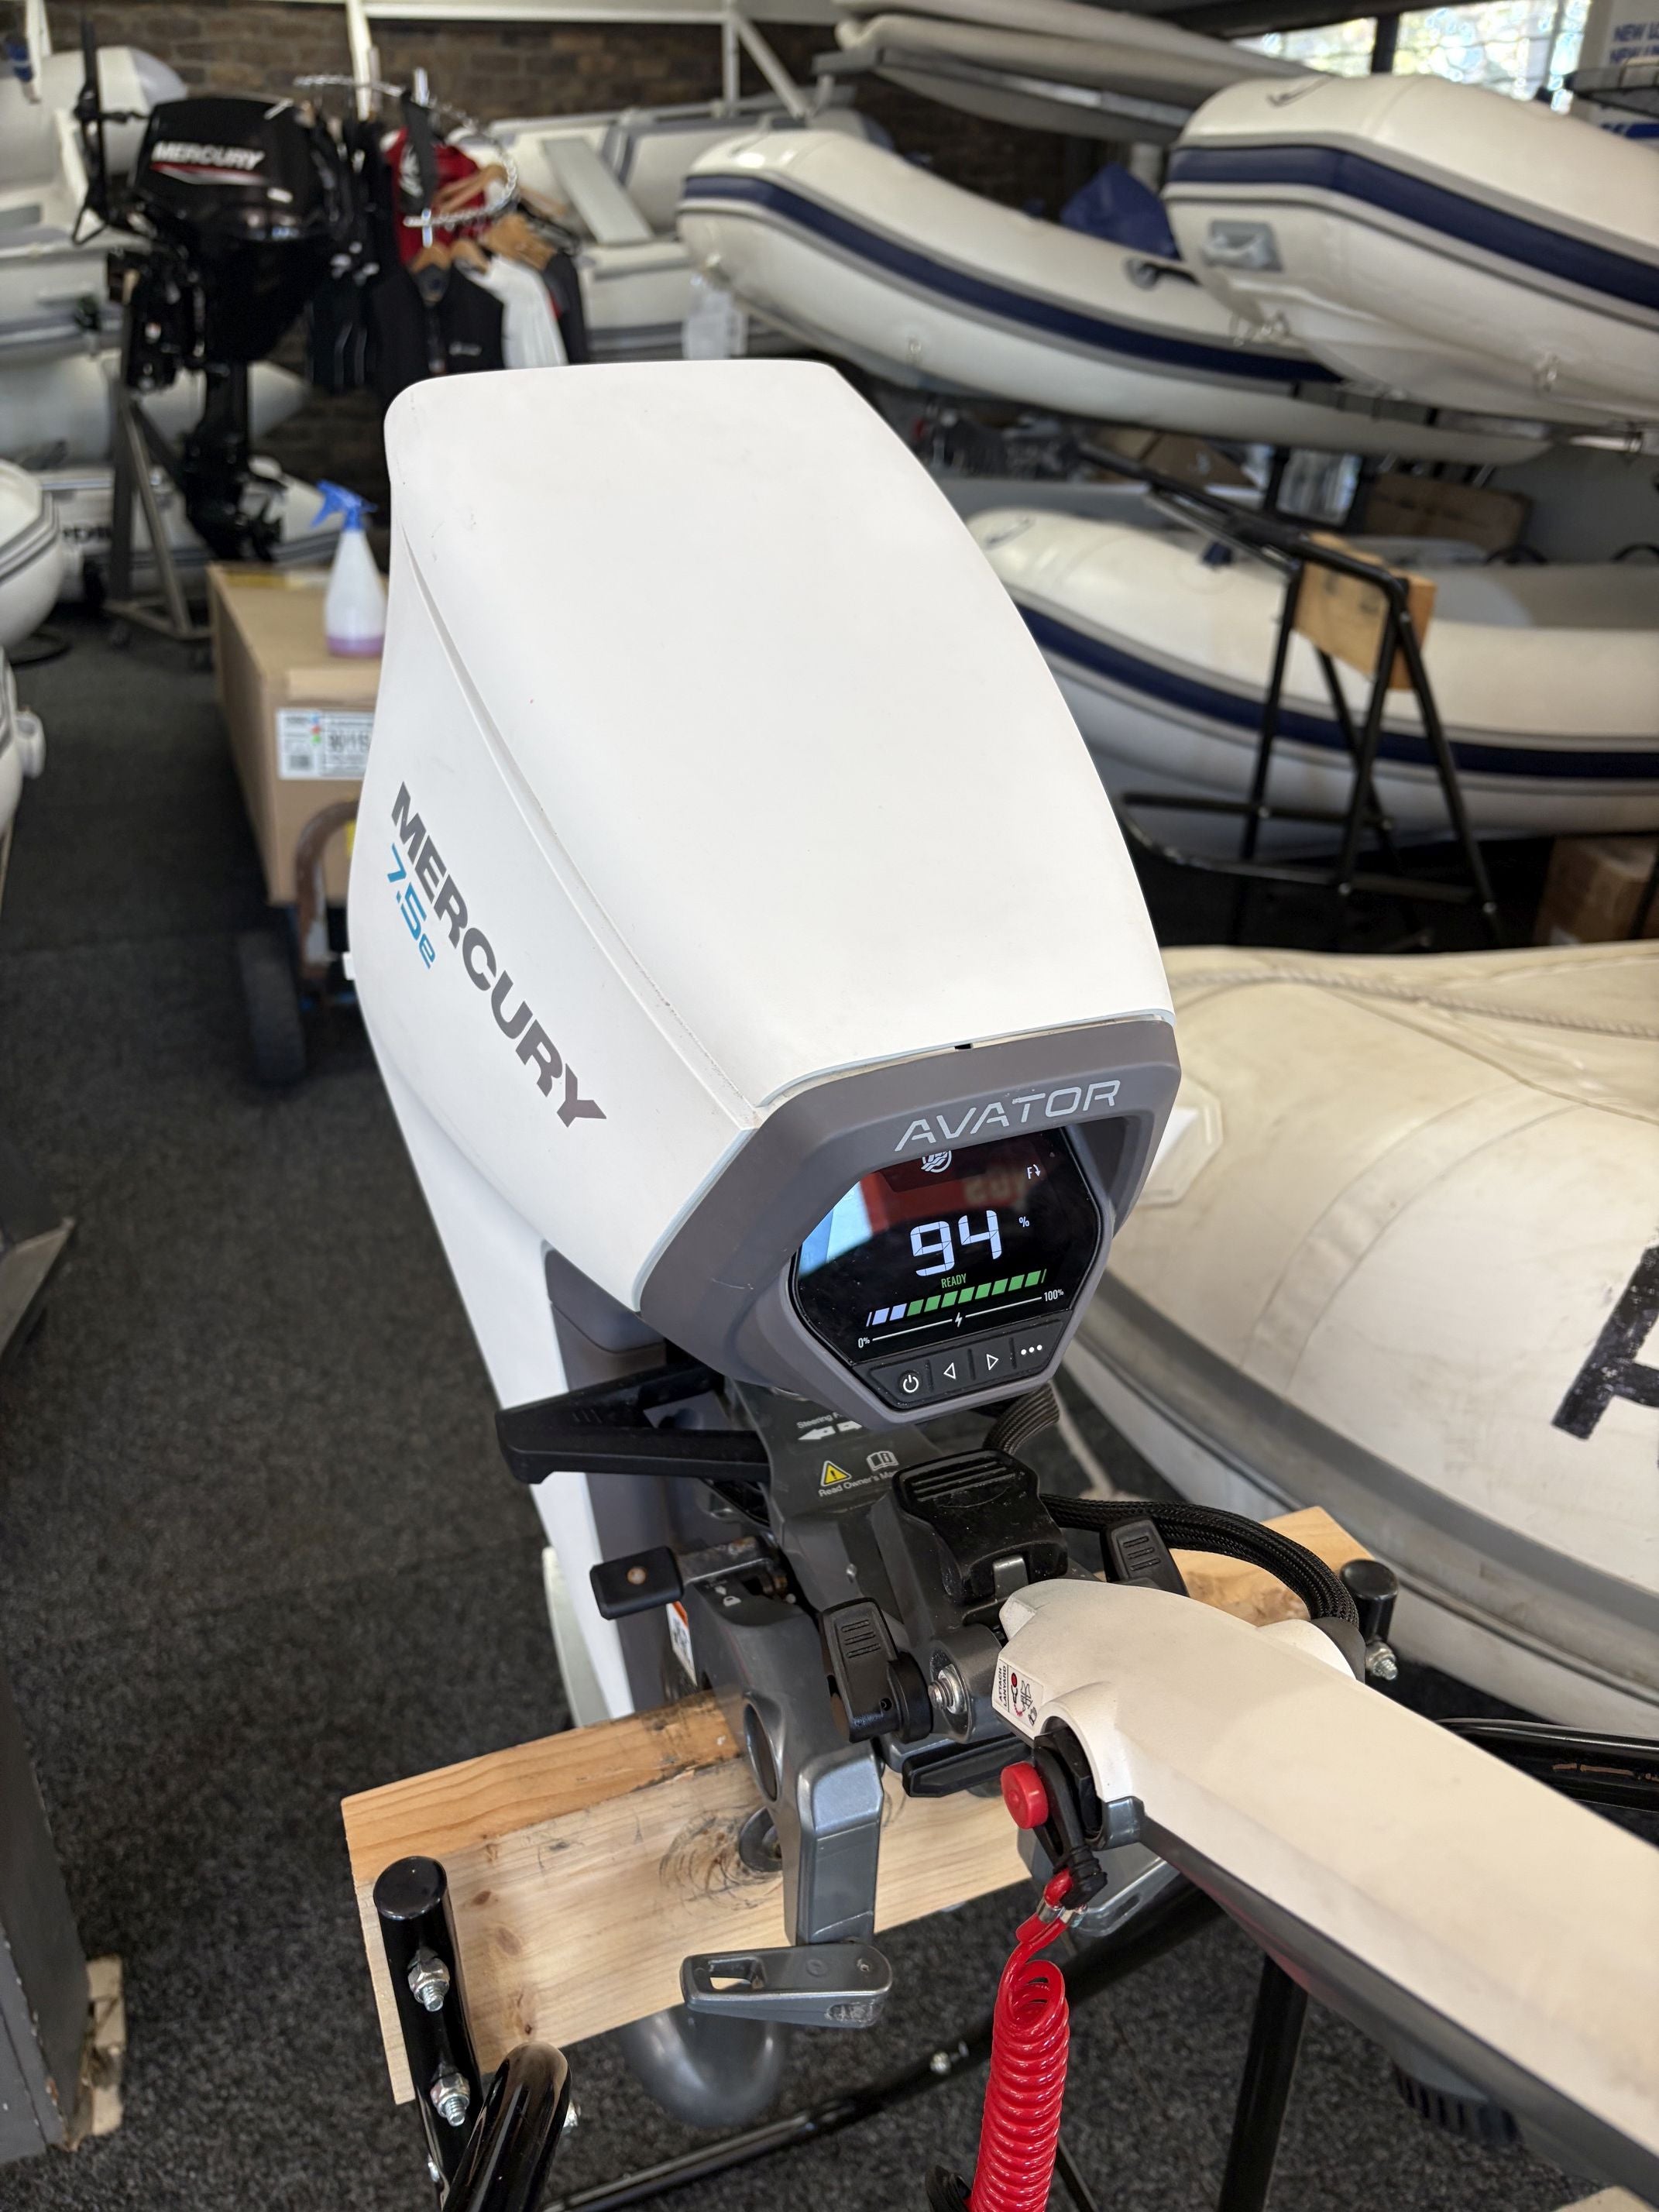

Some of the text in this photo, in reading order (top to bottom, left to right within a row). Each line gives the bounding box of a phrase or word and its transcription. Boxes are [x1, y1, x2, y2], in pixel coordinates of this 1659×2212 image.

[151, 140, 265, 170] MERCURY
[387, 843, 436, 969] 7.5e
[391, 781, 607, 1128] MERCURY
[895, 1080, 1121, 1152] AVATOR
[910, 1210, 1002, 1277] 94
[941, 1273, 967, 1288] READY
[857, 1289, 1064, 1348] 0% 100%
[796, 1414, 833, 1429] Steering
[818, 1485, 843, 1497] Read
[843, 1475, 880, 1489] Owner's
